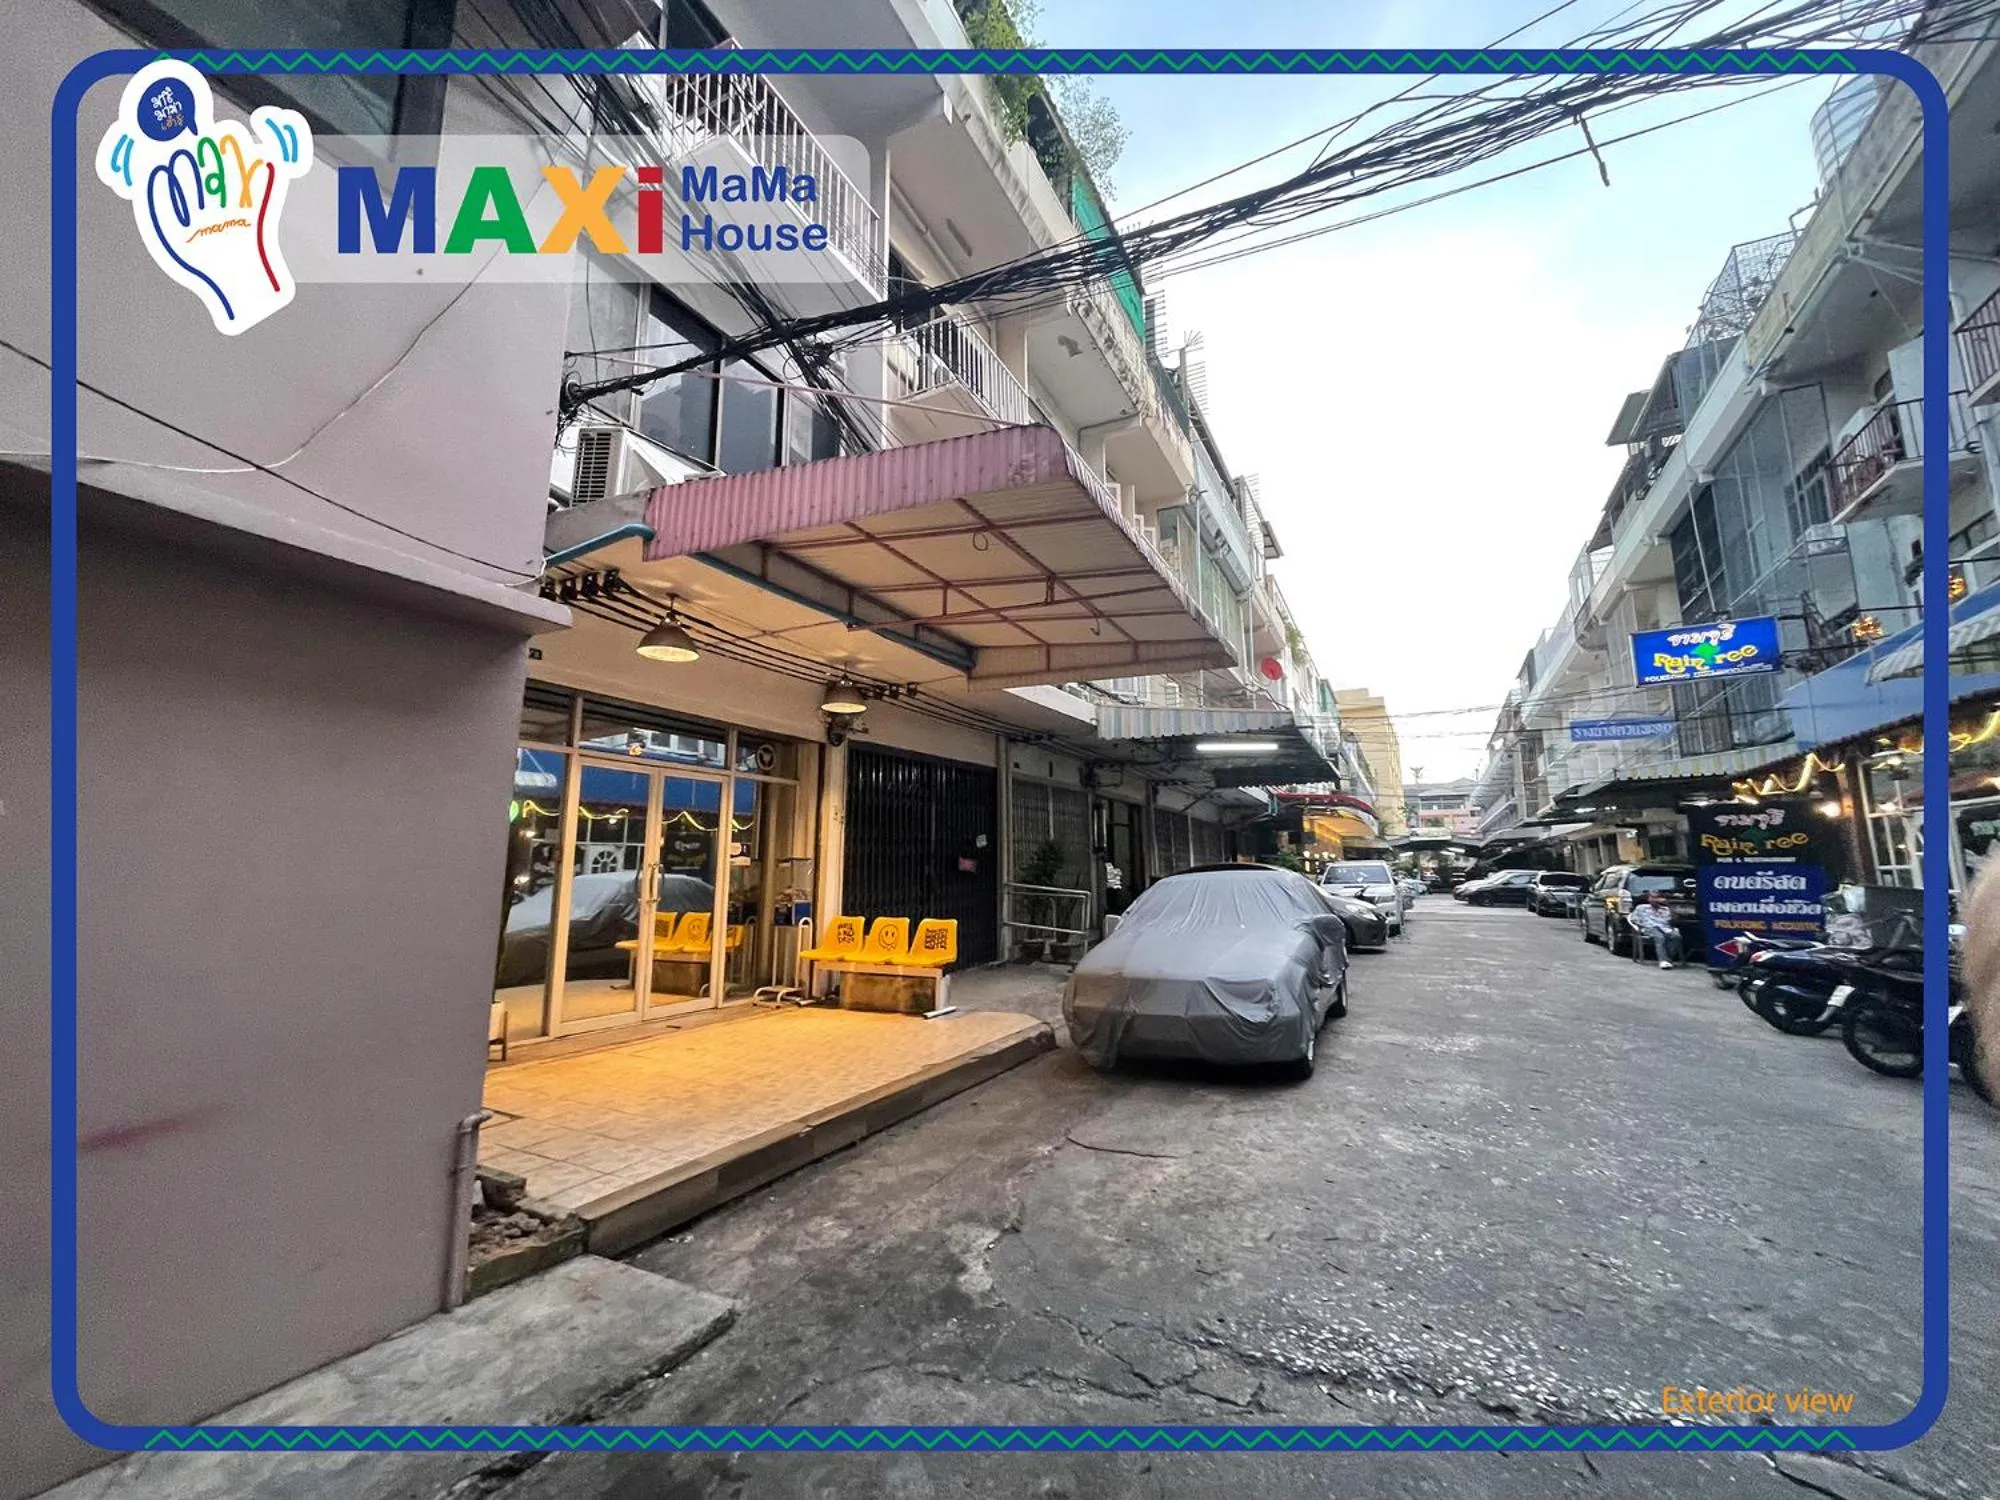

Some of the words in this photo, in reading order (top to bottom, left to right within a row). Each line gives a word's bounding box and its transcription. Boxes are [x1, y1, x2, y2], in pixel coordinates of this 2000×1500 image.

[1713, 870, 1807, 890] ดนตรีสด
[1709, 895, 1822, 915] เพลงเพื่อชีวิต
